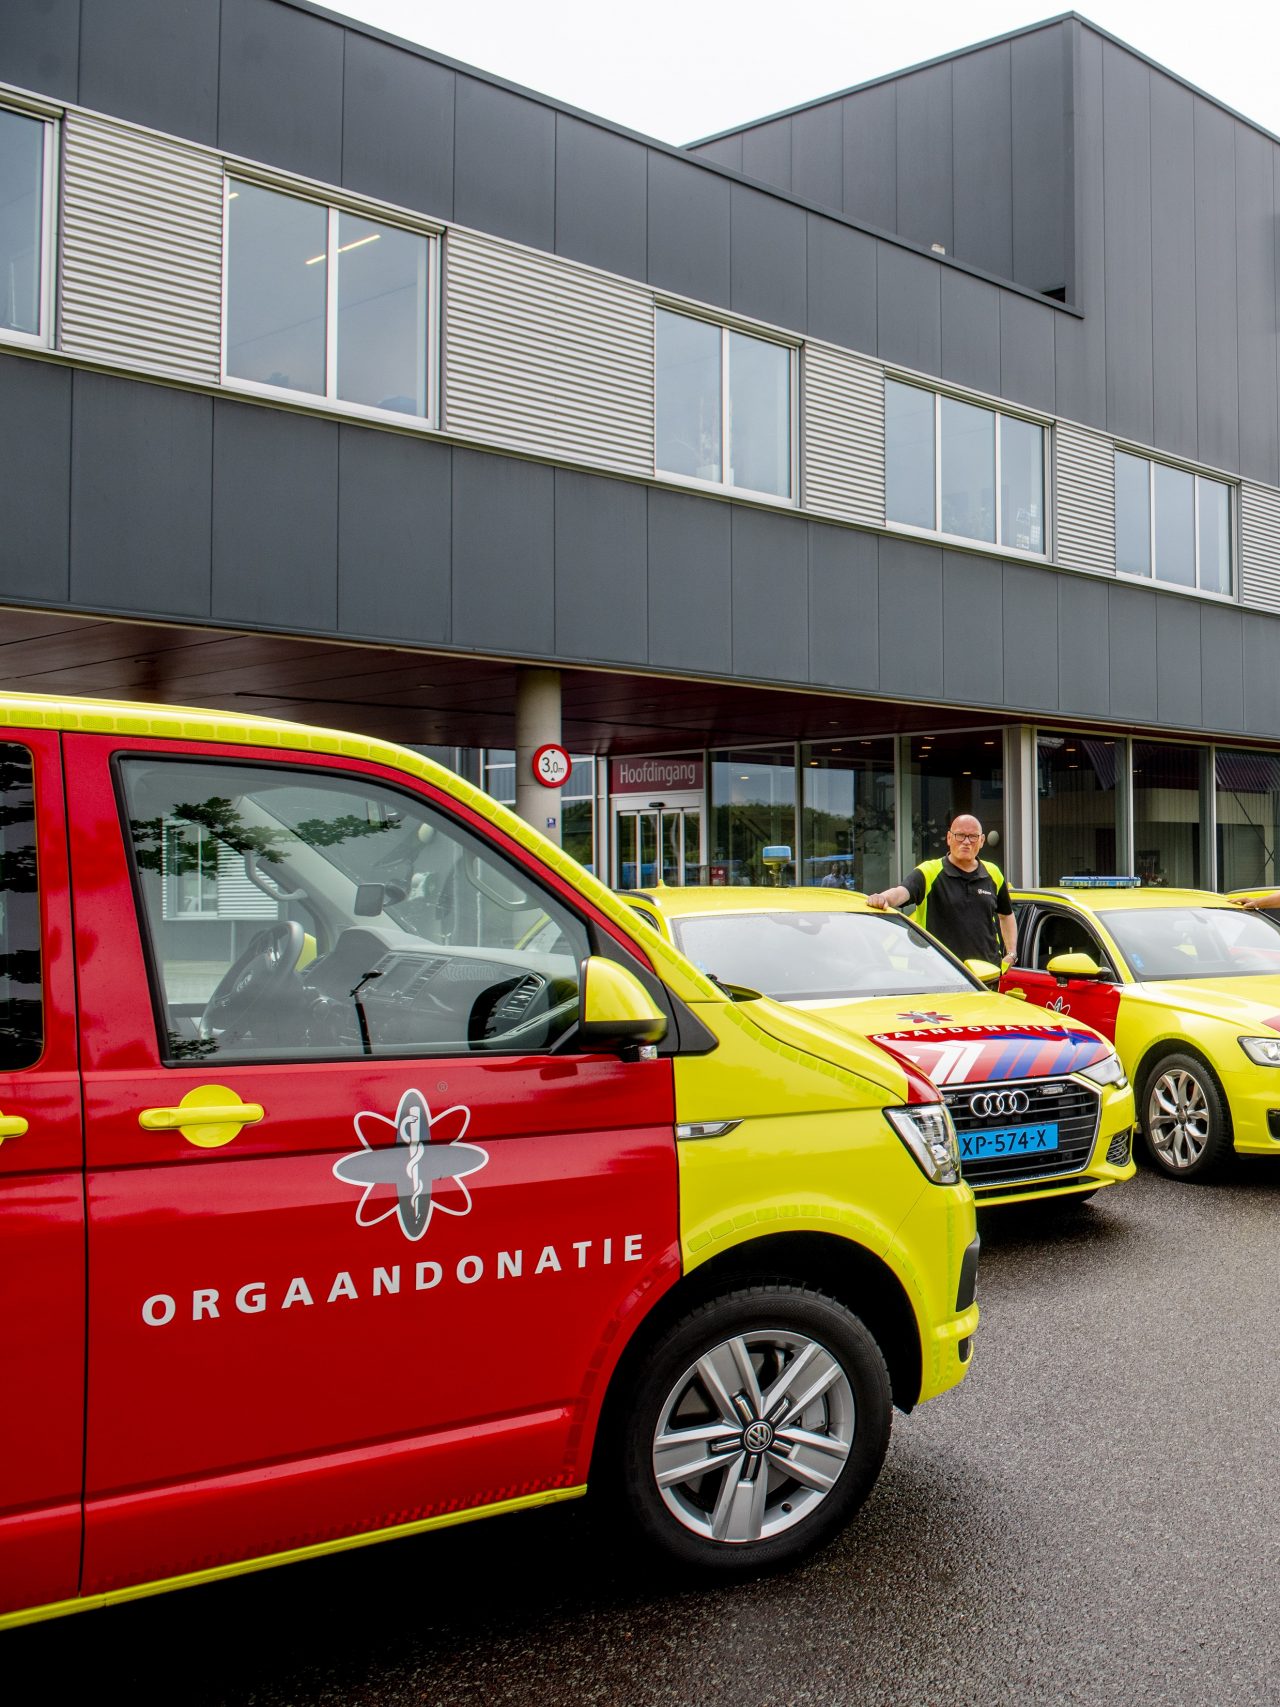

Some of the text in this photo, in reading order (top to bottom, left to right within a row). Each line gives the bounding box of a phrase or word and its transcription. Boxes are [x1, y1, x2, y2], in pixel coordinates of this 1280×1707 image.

[620, 761, 696, 786] Hoofdingang
[961, 1128, 1047, 1157] XP-574-X
[141, 1232, 644, 1327] ORGAANDONATIE
